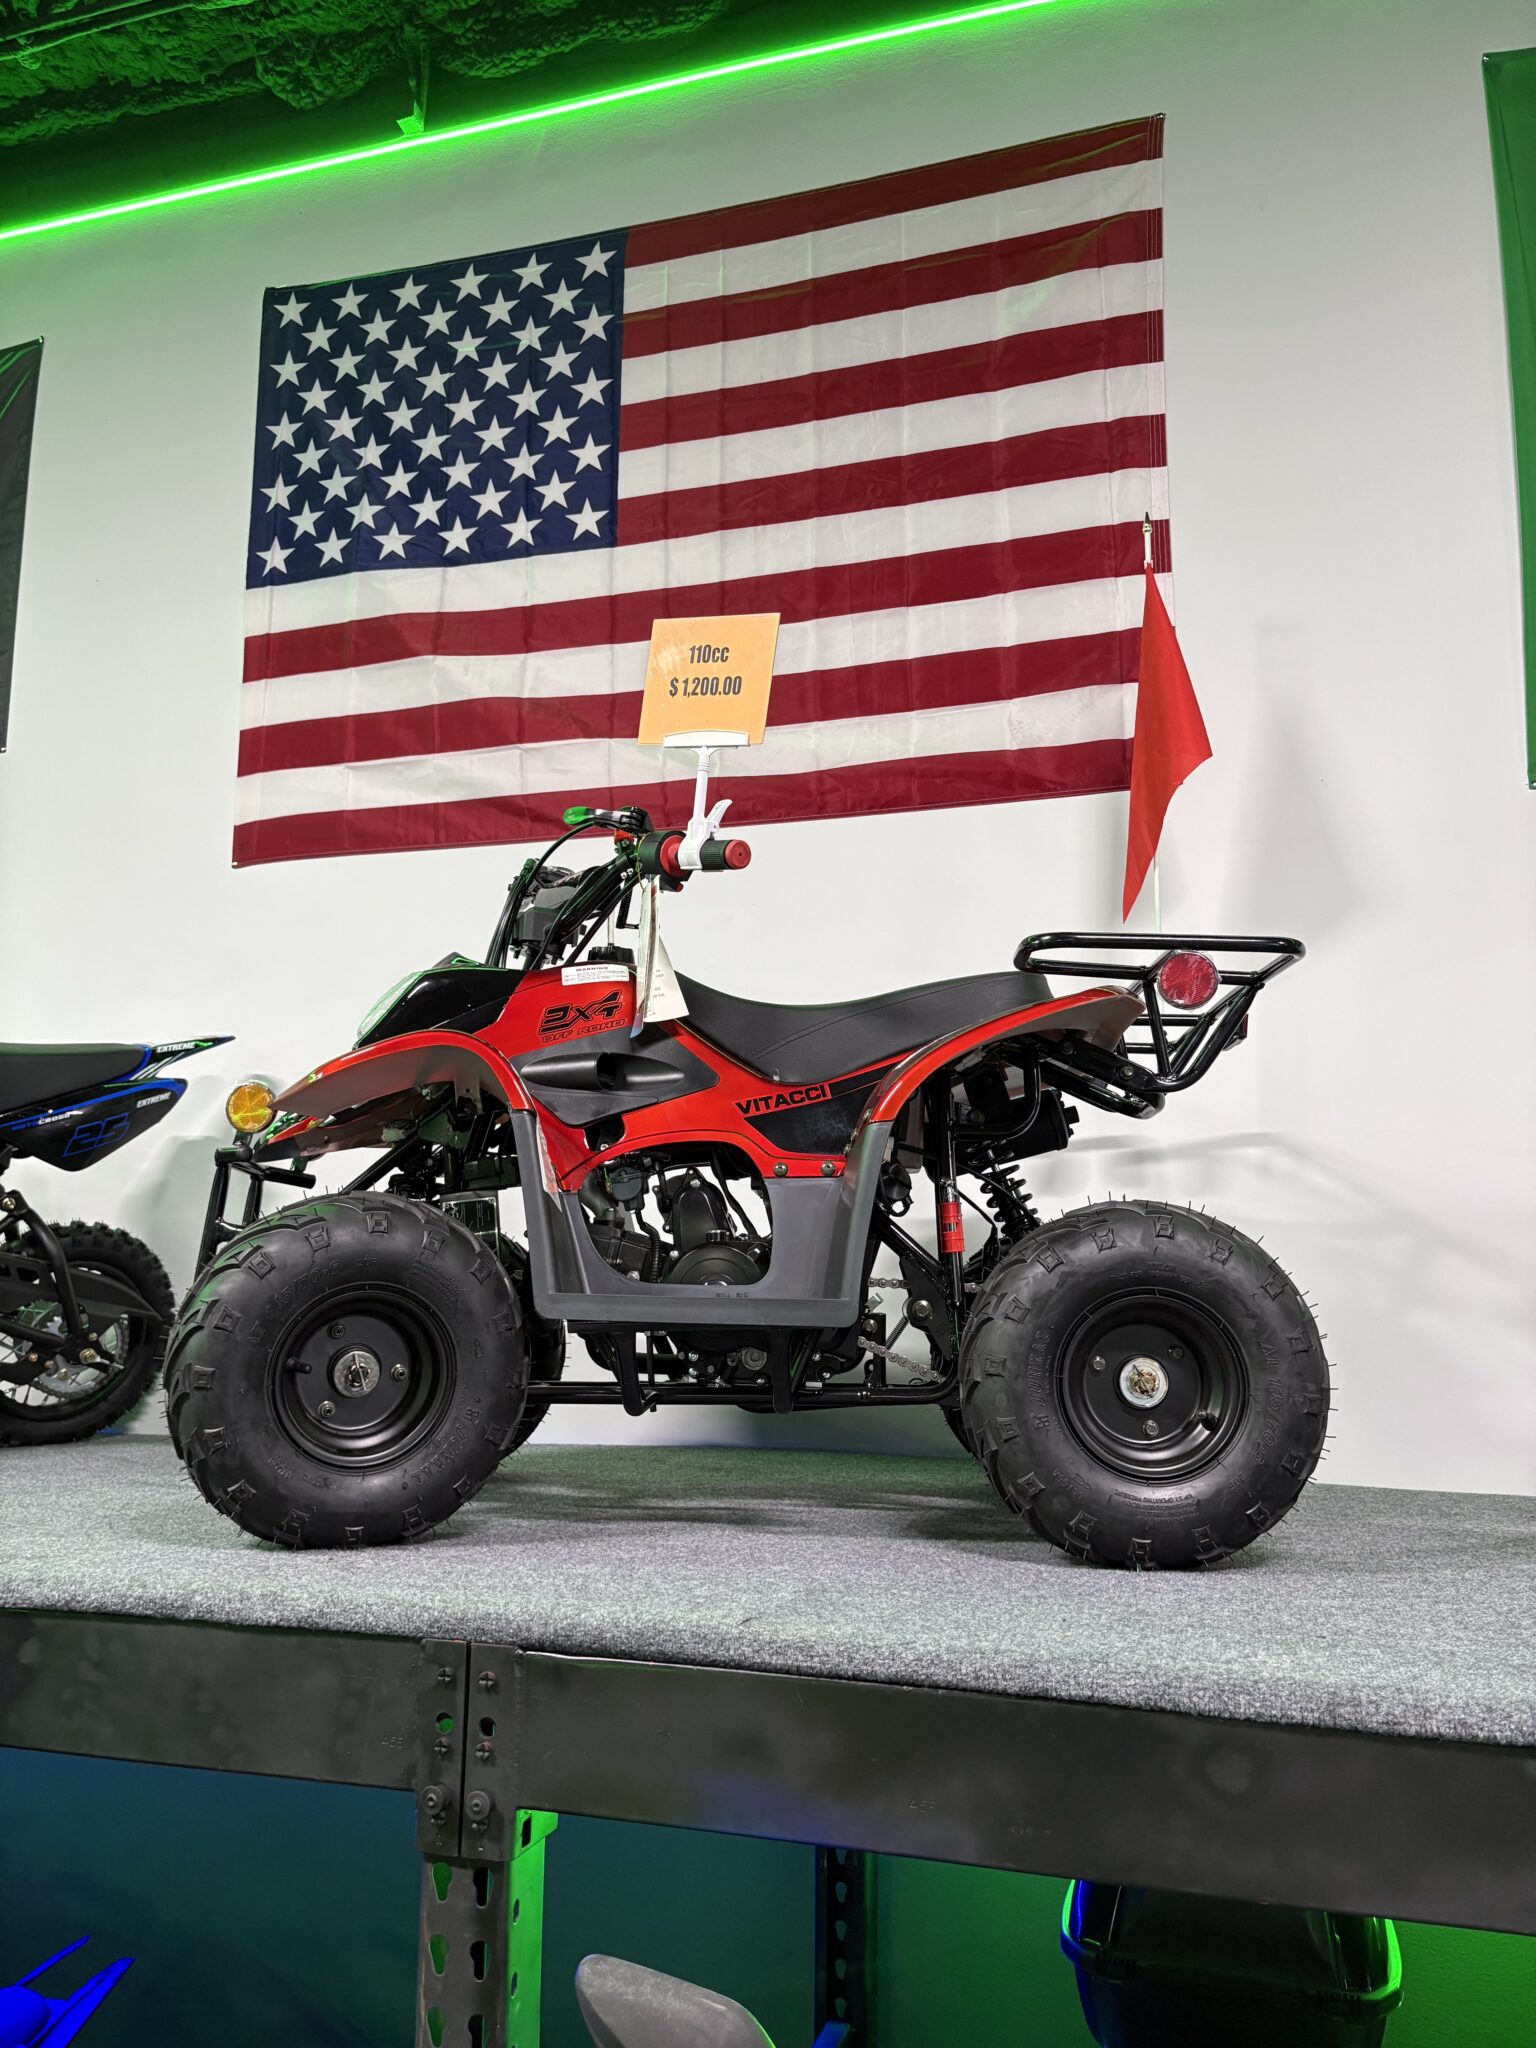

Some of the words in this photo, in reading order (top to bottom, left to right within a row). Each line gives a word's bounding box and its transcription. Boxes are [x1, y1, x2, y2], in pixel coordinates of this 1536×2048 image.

[689, 644, 730, 664] 110cc
[542, 1029, 573, 1043] OFF
[577, 1019, 625, 1036] ROAD
[156, 1042, 196, 1053] EXTREME
[136, 1092, 172, 1108] EXTREME
[735, 1084, 828, 1115] VITACCI
